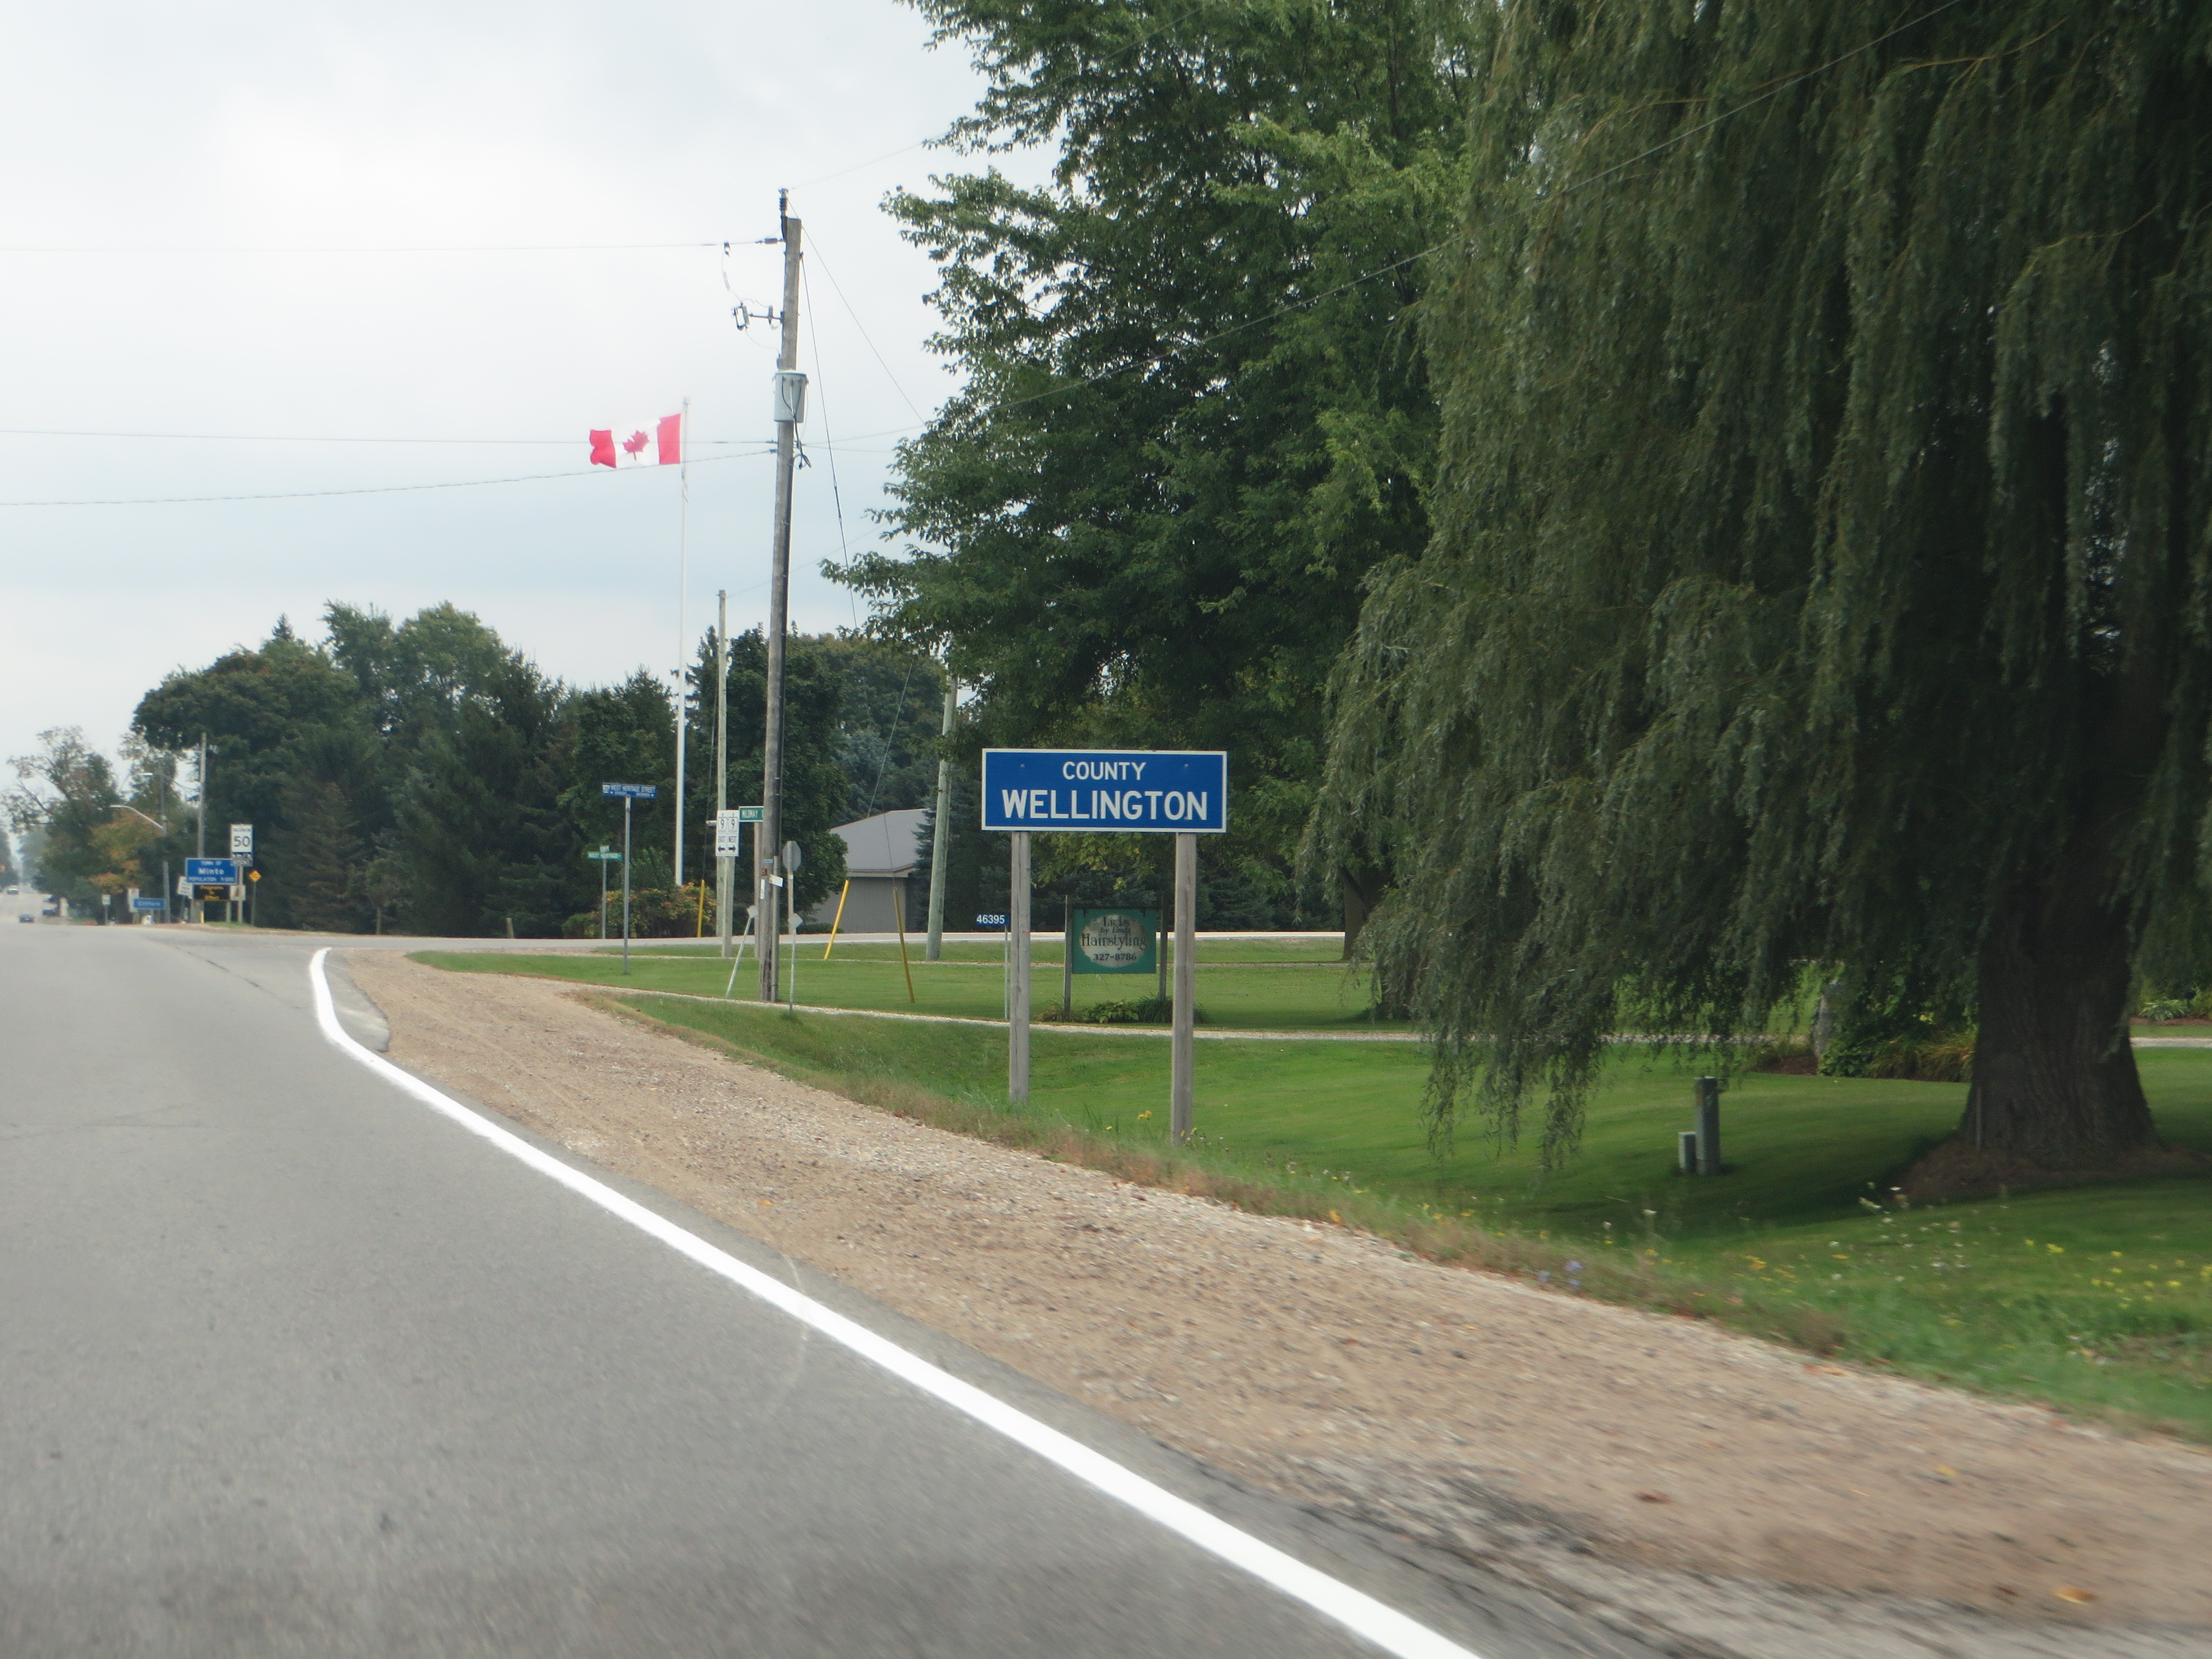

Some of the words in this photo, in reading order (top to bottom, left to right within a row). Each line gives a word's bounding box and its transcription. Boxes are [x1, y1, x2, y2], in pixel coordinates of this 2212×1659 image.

[1062, 761, 1147, 781] COUNTY
[1001, 789, 1208, 821] WELLINGTON
[721, 819, 725, 829] 9
[731, 819, 735, 829] 9
[233, 836, 251, 847] 50
[976, 914, 1005, 924] 46395
[1100, 927, 1108, 935] by
[1082, 933, 1147, 951] Hairstyling
[1093, 953, 1138, 961] 327-8786
